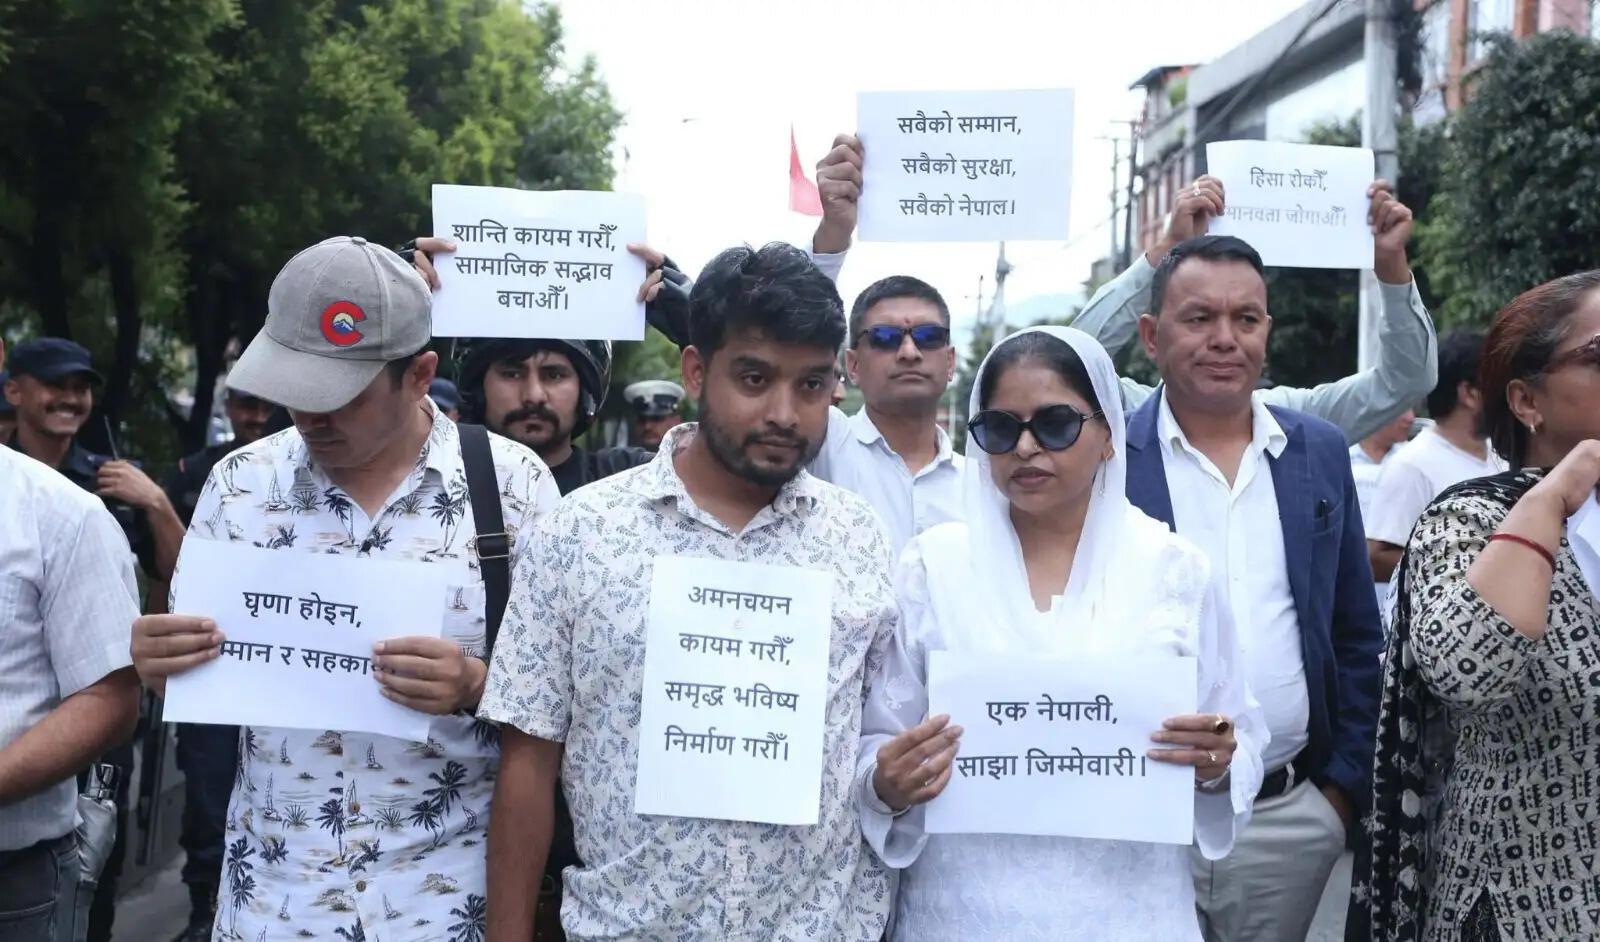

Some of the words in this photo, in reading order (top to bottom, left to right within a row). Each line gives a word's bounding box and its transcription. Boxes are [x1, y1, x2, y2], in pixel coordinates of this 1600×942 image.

[897, 110, 953, 133] सबैको
[957, 115, 1021, 135] सम्मान,
[901, 152, 957, 174] सबैको
[961, 158, 1016, 180] सुरक्षा,
[1250, 166, 1284, 188] हिंसा
[899, 192, 954, 216] सबैको
[958, 193, 1015, 216] नेपाल।
[452, 219, 508, 244] शान्ति
[513, 227, 572, 247] कायम
[577, 224, 617, 251] गरौँ,
[454, 252, 548, 277] सामाजिक
[553, 261, 613, 283] सद्भाव
[497, 285, 568, 310] बचाऔँ।
[242, 591, 293, 618] घृणा
[298, 592, 362, 628] होइन,
[688, 586, 792, 615] अमनचयन
[219, 640, 274, 664] म्मान
[280, 646, 295, 666] र
[679, 632, 743, 657] कायम
[748, 635, 794, 666] गरौँ,
[664, 681, 726, 709] समृद्ध
[733, 682, 800, 712] भविष्य
[986, 701, 1029, 726] एक
[1036, 693, 1118, 725] नेपाली,
[664, 724, 736, 755] निर्माण
[742, 731, 789, 761] गरौँ।
[956, 756, 1018, 780] साझा
[1025, 747, 1146, 777] जिम्मेवारी।
